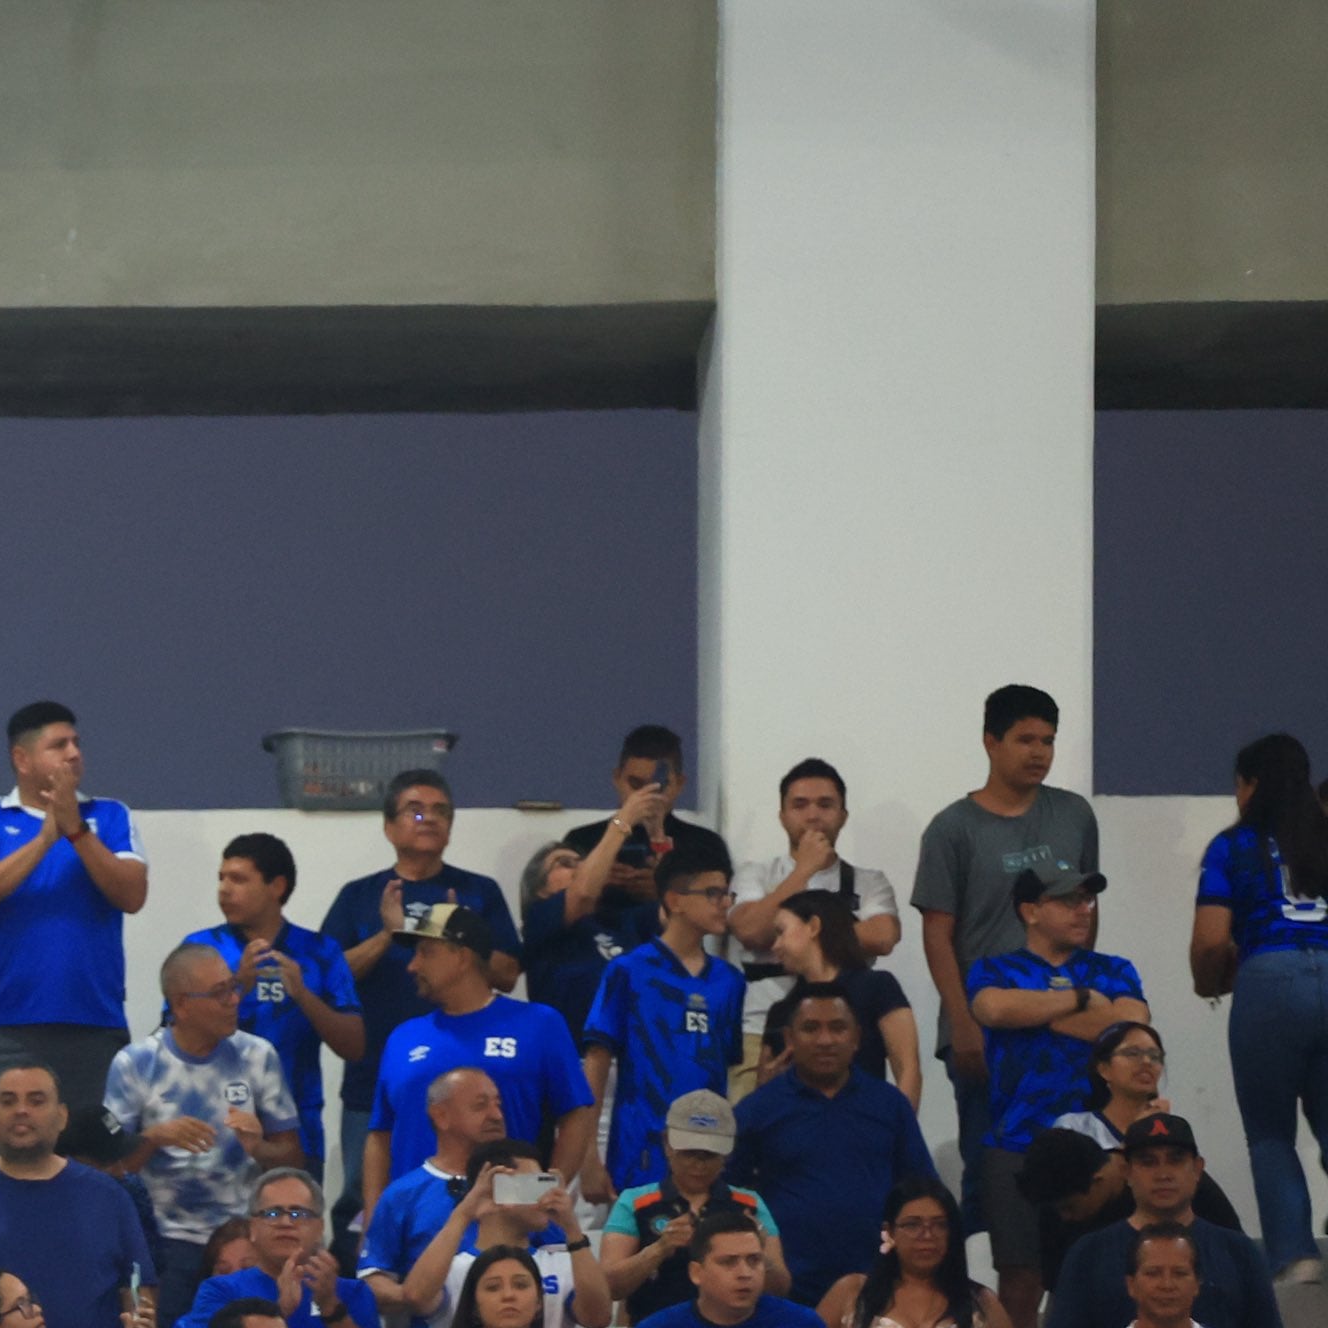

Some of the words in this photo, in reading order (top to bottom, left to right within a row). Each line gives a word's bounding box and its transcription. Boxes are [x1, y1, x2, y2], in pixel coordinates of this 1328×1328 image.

[256, 982, 284, 1002] ES
[686, 1012, 709, 1034] ES
[485, 1037, 516, 1058] ES
[540, 1274, 560, 1295] S
